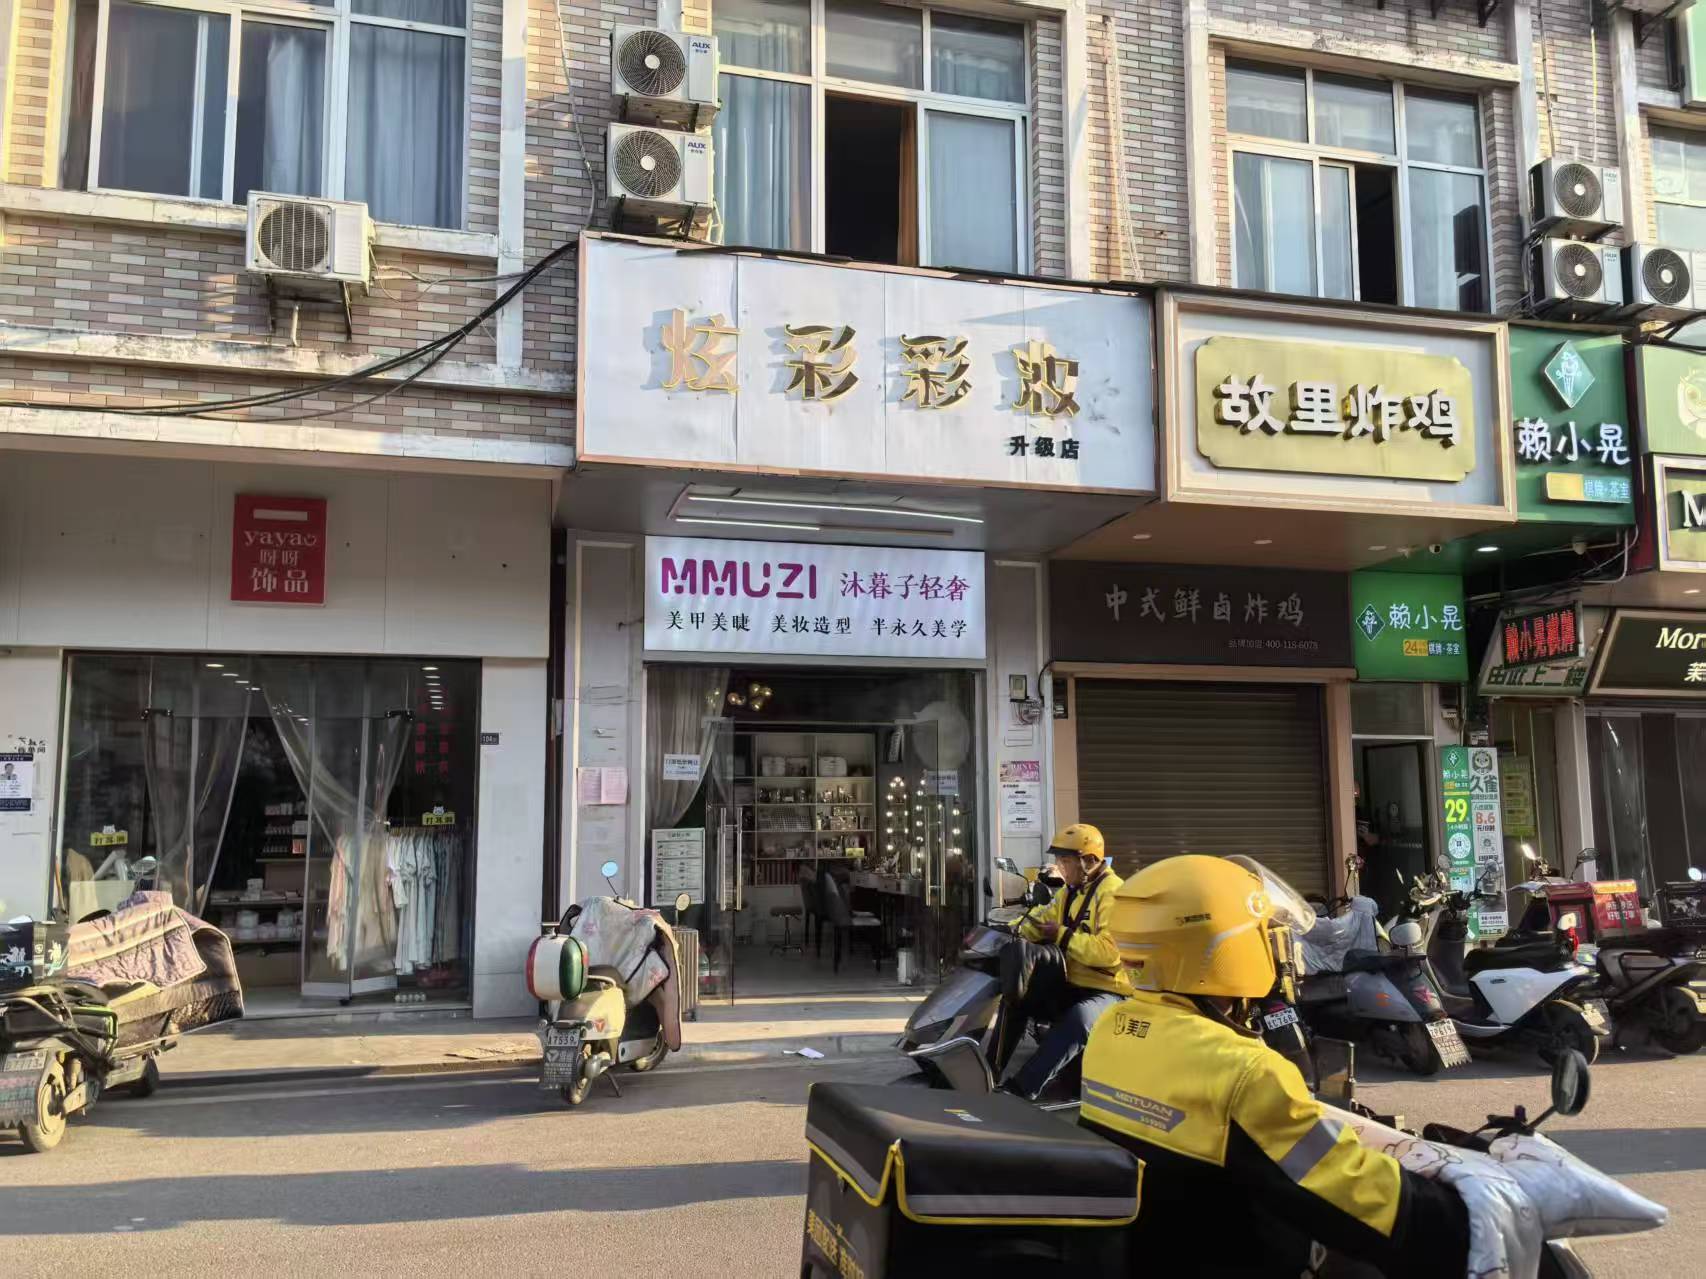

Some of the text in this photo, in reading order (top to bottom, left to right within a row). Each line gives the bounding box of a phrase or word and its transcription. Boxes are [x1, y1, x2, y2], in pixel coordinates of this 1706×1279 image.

[1213, 373, 1460, 449] 故里炸鸡
[1009, 434, 1081, 460] 升级店
[1517, 417, 1631, 466] 赖小晃
[251, 567, 309, 593] 饰品
[661, 557, 817, 599] MMUZI
[839, 571, 970, 602] 沐暮子轻奢
[1104, 583, 1304, 626] 中式鲜卤炸鸡
[1389, 603, 1463, 631] 赖小晃
[667, 610, 968, 638] 美甲美睫 美妆造型 半永久美学
[1445, 798, 1468, 823] 29
[1476, 812, 1496, 824] 8.6
[1126, 1018, 1152, 1039] 美团
[1114, 1091, 1174, 1118] MEITUAN
